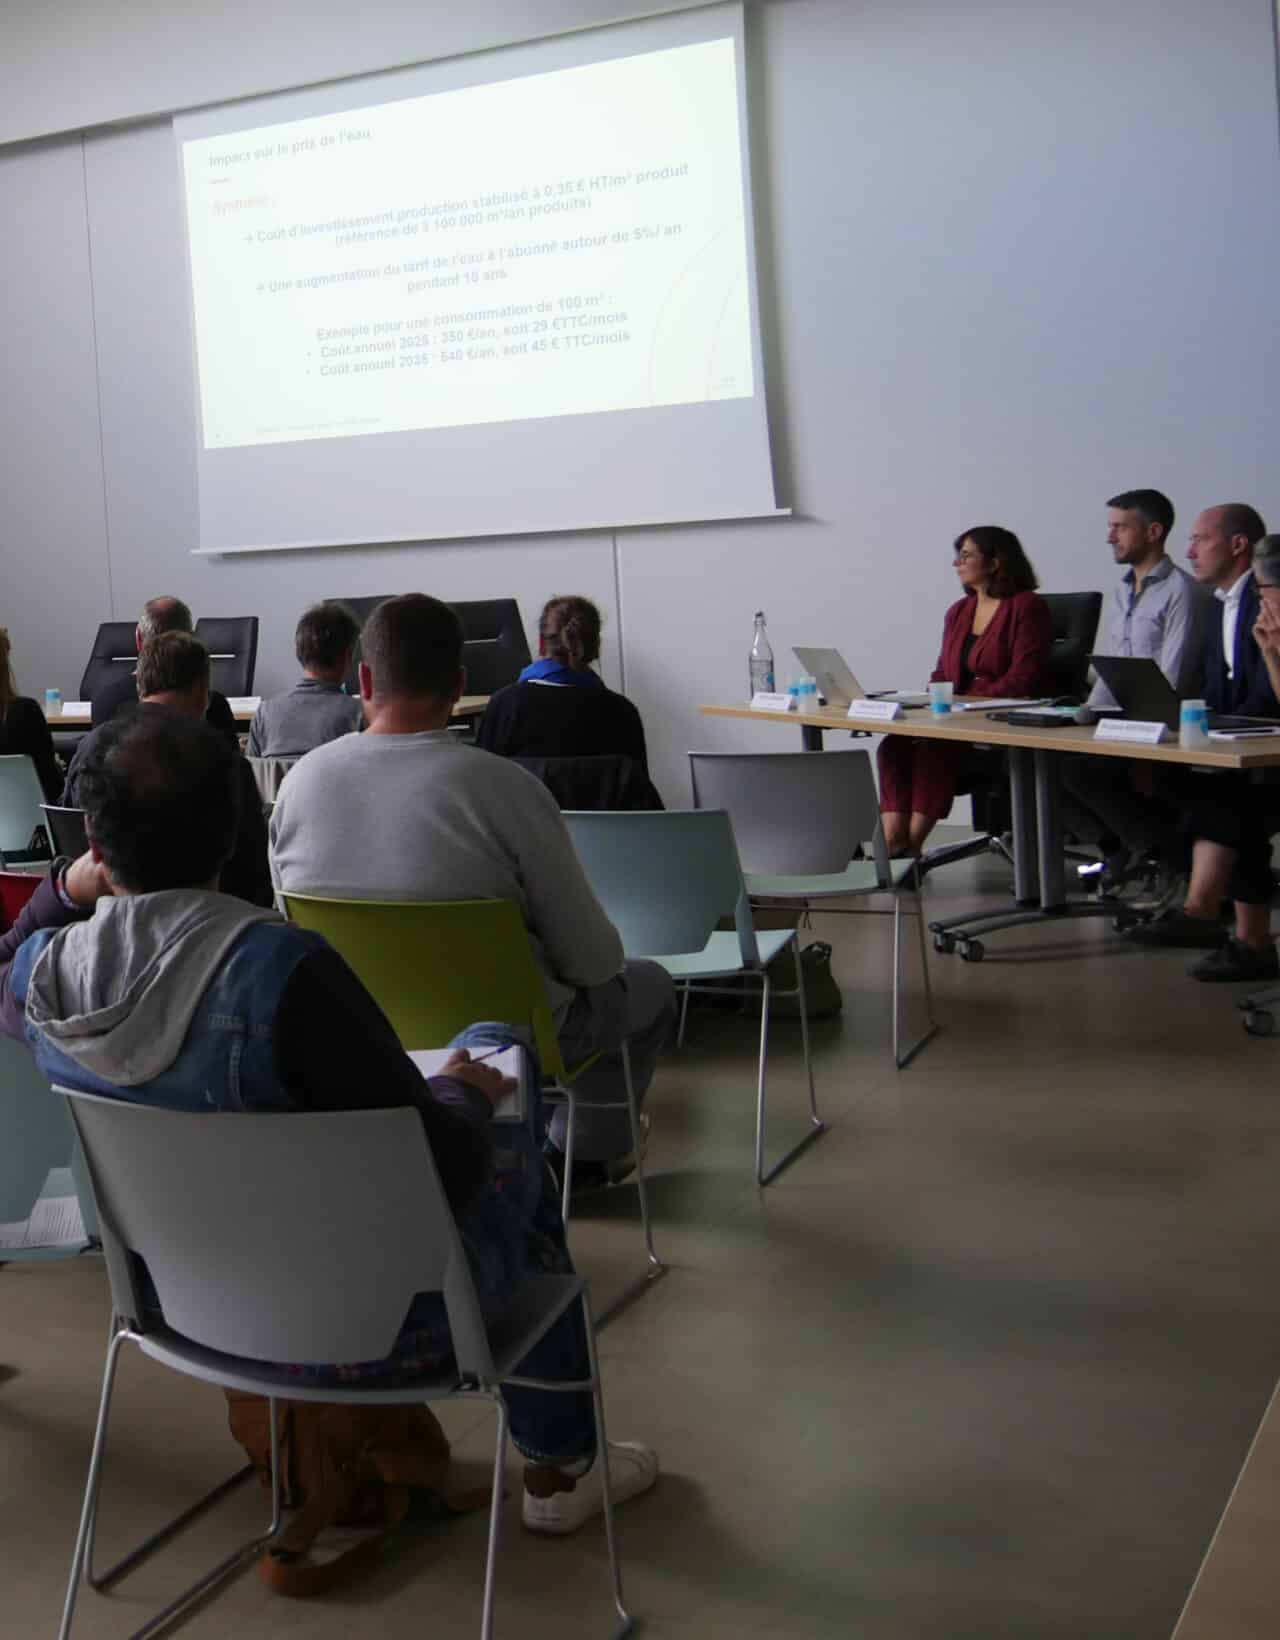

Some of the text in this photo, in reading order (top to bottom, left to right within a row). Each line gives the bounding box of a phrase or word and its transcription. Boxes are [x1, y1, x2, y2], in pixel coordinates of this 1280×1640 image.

[292, 138, 316, 157] prix
[398, 200, 469, 224] production
[636, 161, 689, 185] produit
[295, 269, 380, 291] augmentation
[562, 233, 609, 251] autour
[407, 271, 460, 295] pendant
[434, 303, 533, 327] consommation
[352, 338, 397, 355] annuel
